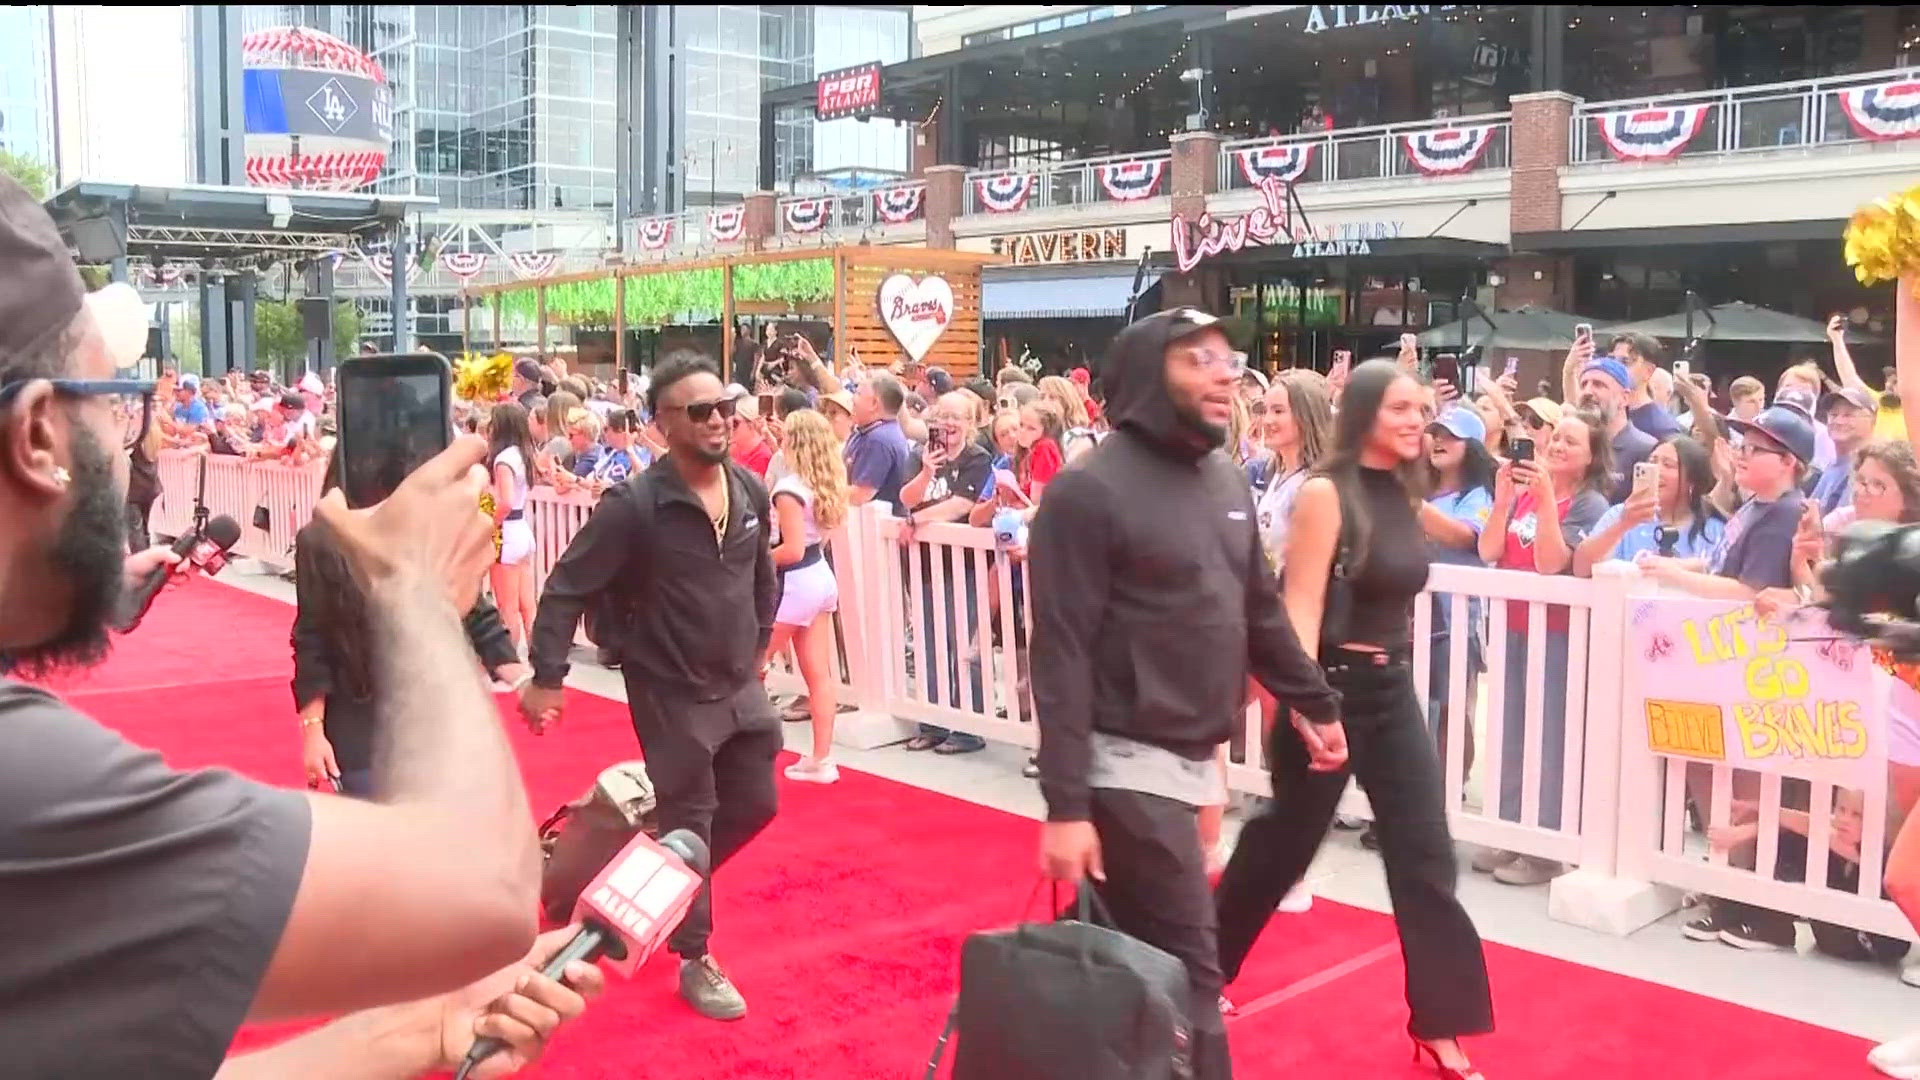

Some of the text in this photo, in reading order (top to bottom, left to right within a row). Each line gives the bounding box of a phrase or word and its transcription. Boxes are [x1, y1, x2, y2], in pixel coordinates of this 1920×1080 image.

[821, 88, 876, 111] ATLANTA
[823, 74, 873, 97] PBR
[323, 86, 345, 120] LA
[1172, 173, 1286, 272] Live!
[1003, 229, 1127, 264] TAVERN
[1292, 240, 1371, 258] ATLANTA
[891, 296, 937, 321] Braves
[1745, 656, 1809, 699] GO
[1733, 699, 1868, 760] BRAVES
